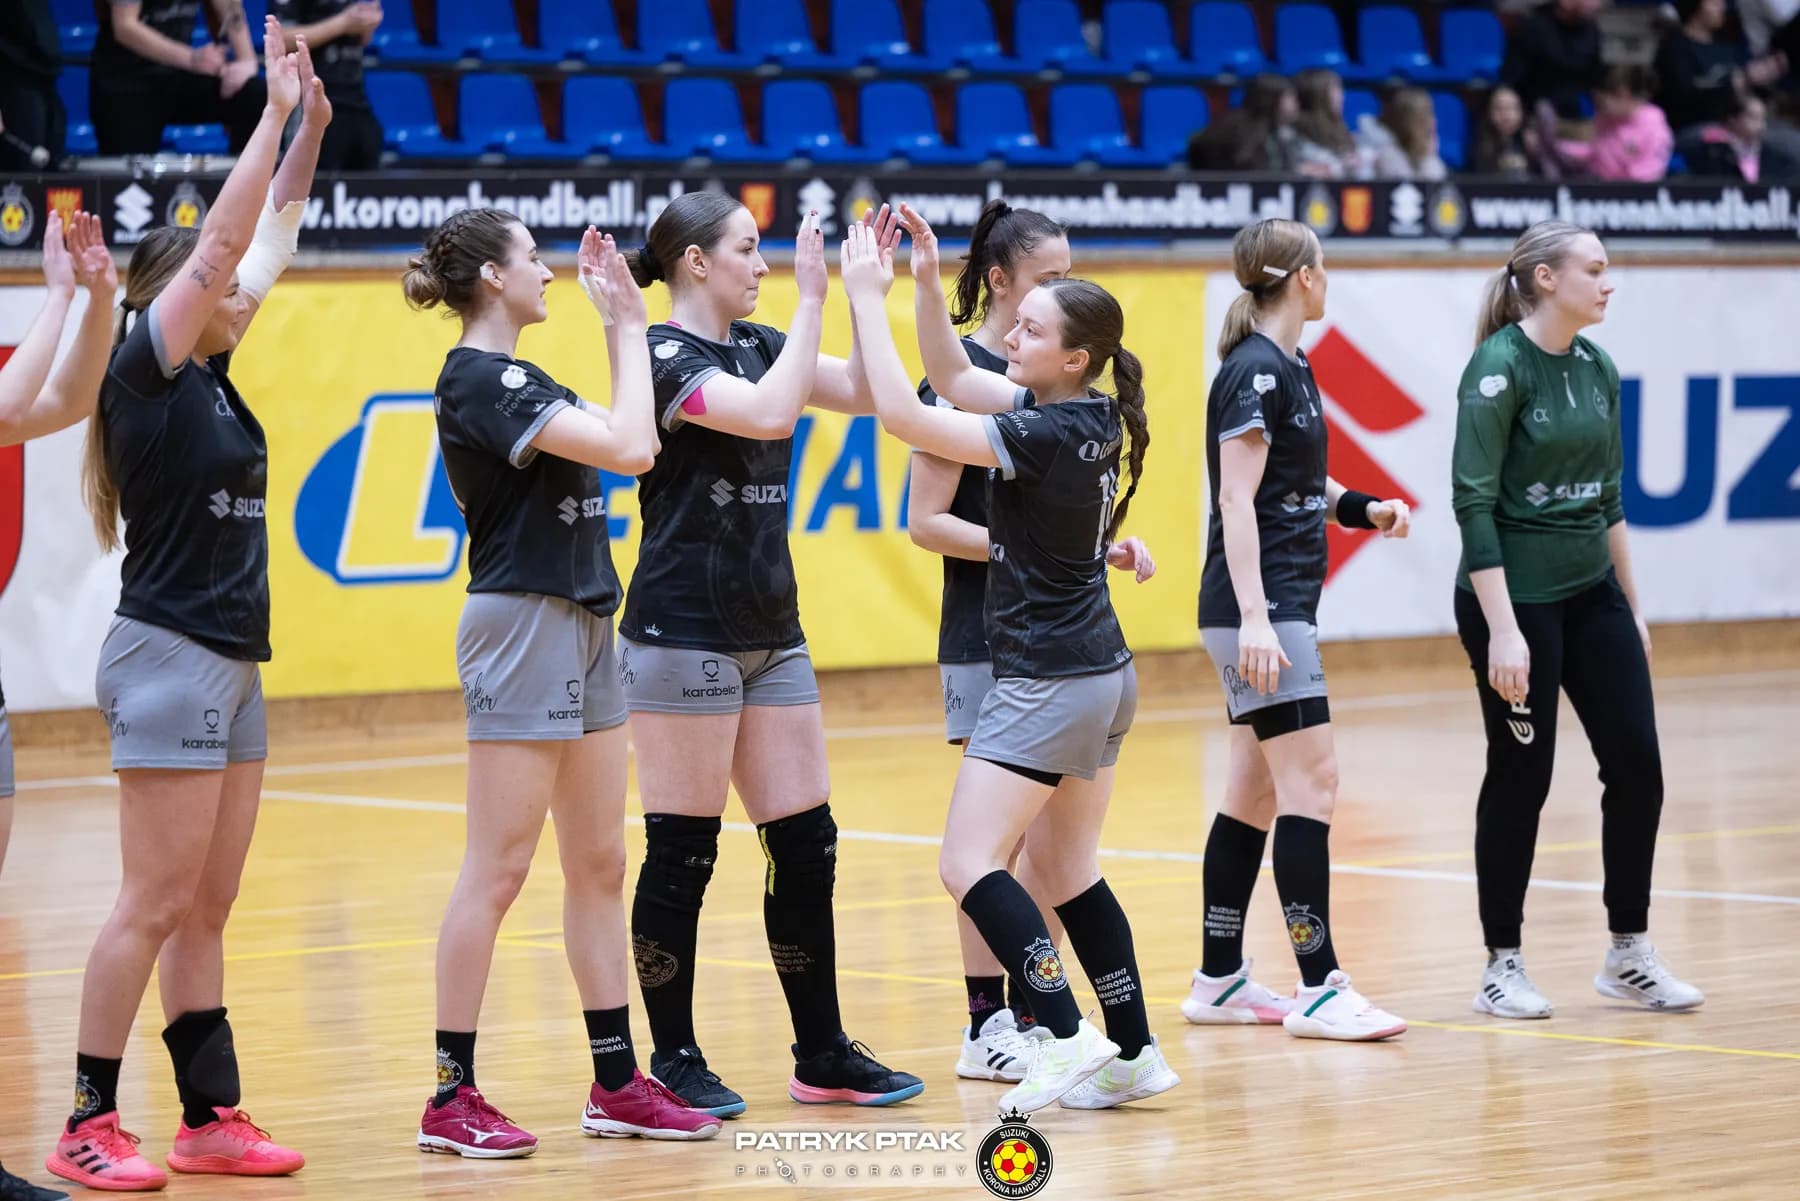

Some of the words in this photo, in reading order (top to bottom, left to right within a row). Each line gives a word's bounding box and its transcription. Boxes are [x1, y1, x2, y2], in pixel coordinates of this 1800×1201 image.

[495, 391, 514, 412] Sun
[1095, 967, 1127, 985] SUZUKI
[1097, 975, 1132, 992] KORONA
[1104, 993, 1132, 1007] KIELCE
[592, 1042, 629, 1055] ANDBALL
